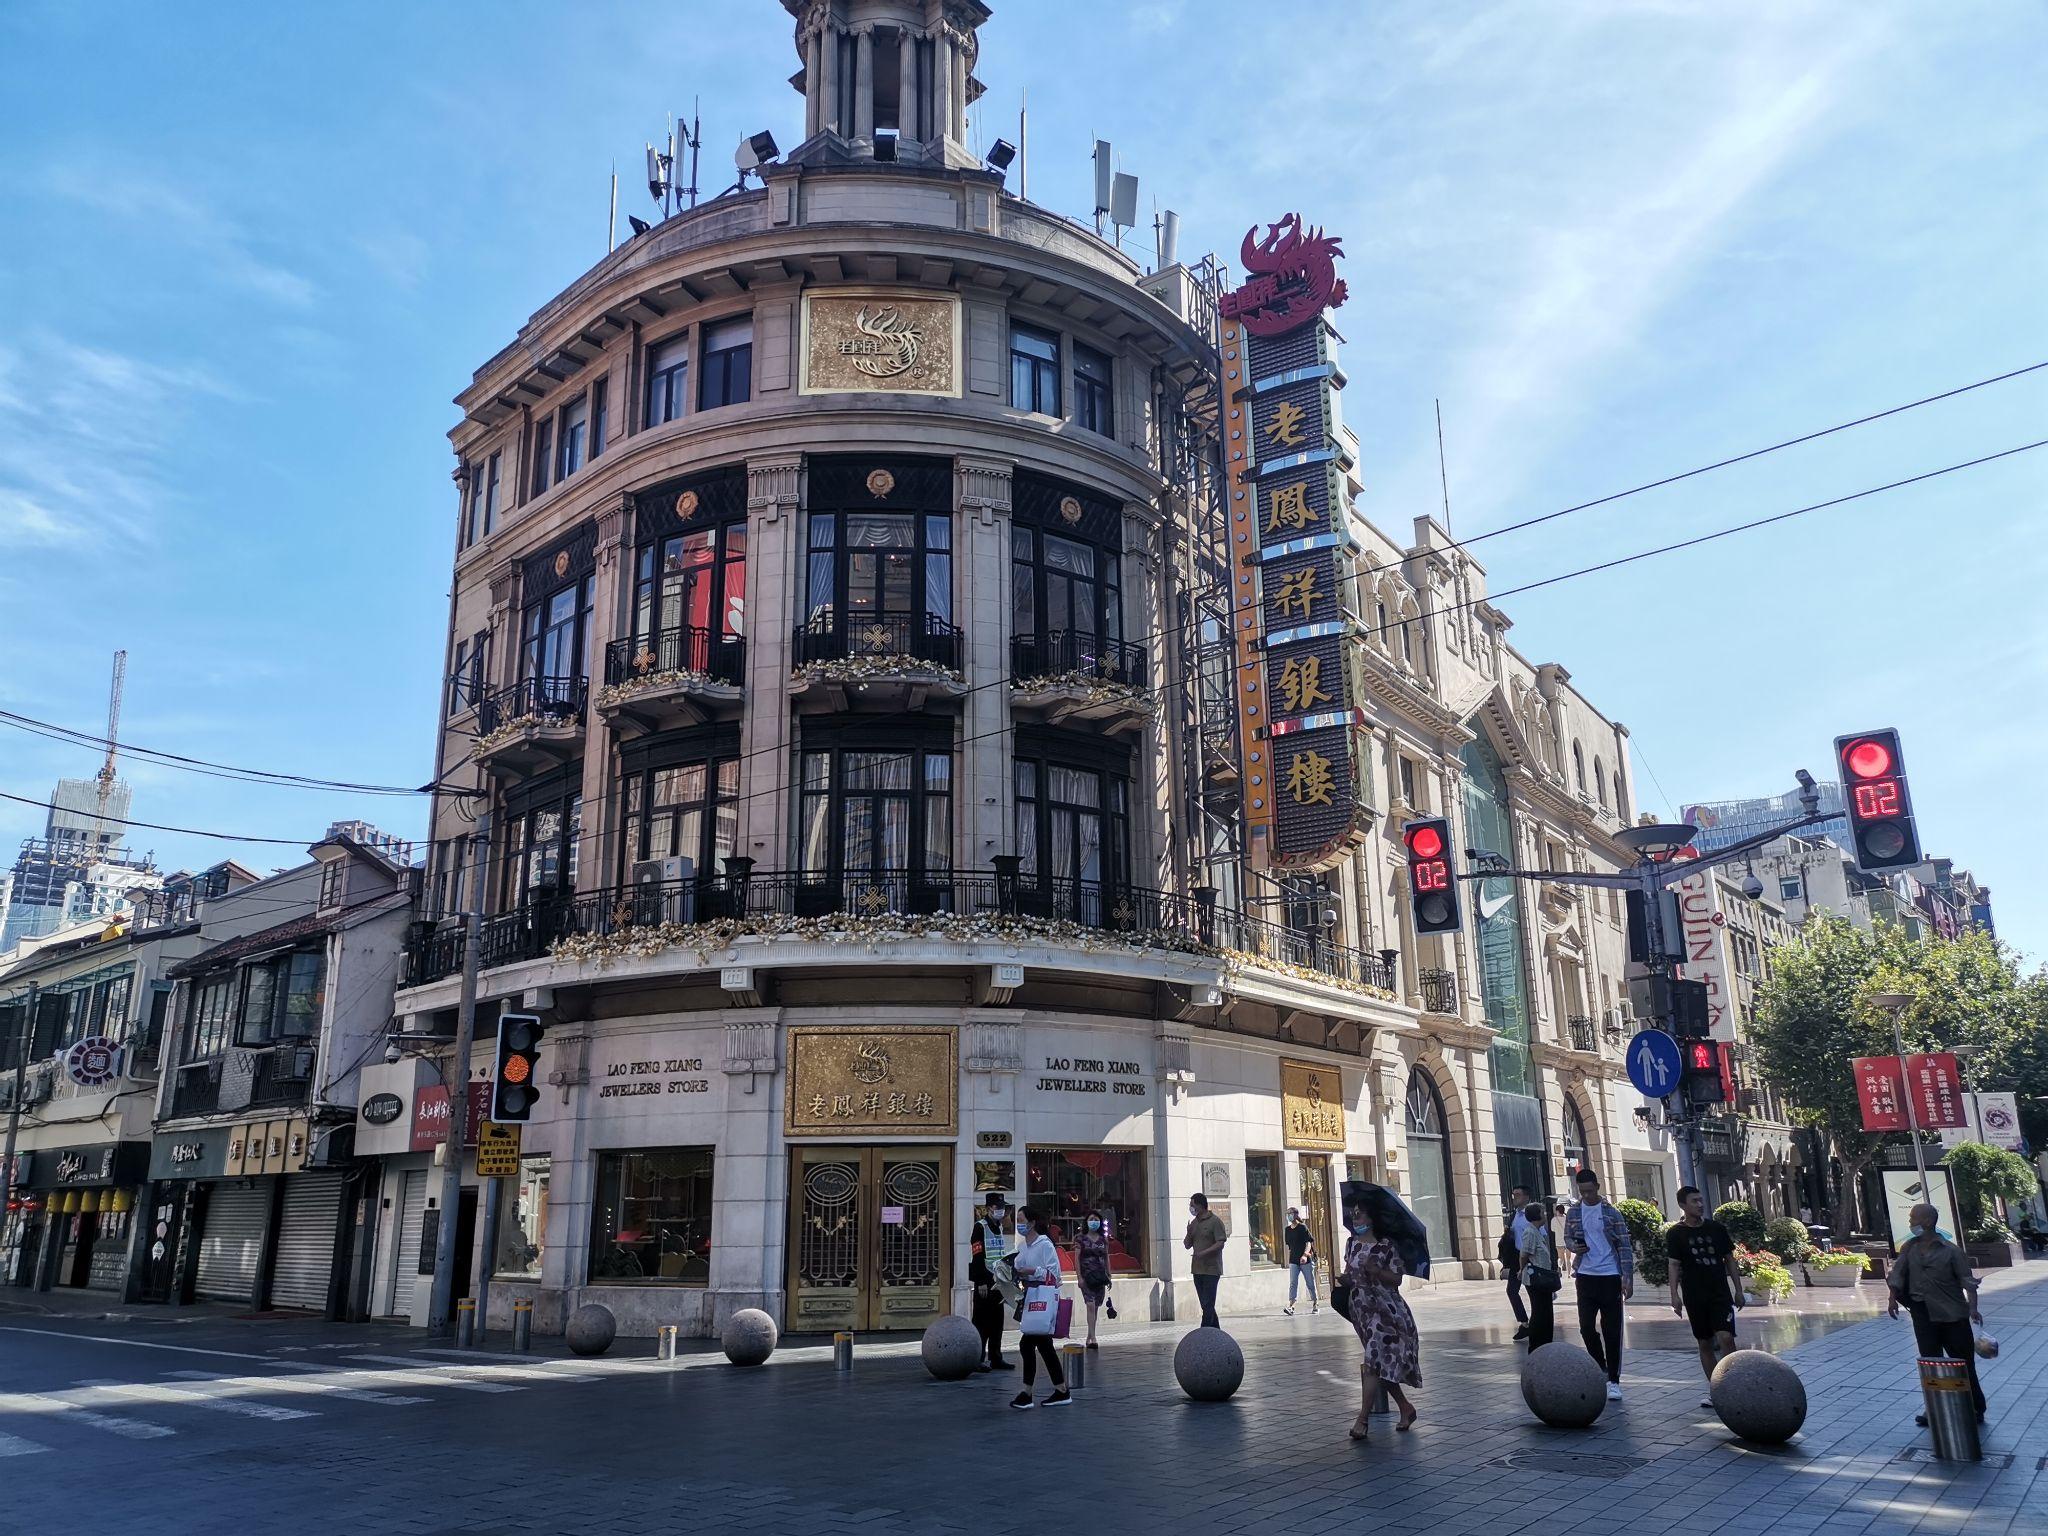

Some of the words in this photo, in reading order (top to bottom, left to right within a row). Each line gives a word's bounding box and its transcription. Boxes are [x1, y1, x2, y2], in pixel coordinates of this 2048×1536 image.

[1264, 401, 1337, 806] 老鳳祥銀樓
[1855, 782, 1898, 817] 02
[1416, 861, 1447, 889] 02
[1679, 872, 1716, 962] GUJIN
[608, 1063, 627, 1076] LAO
[630, 1061, 660, 1075] FENG
[664, 1059, 703, 1073] XIANG
[1046, 1058, 1070, 1071] LAO
[1074, 1059, 1104, 1073] FENG
[1108, 1061, 1140, 1075] XIANG
[600, 1082, 661, 1098] JEWELLERS
[668, 1080, 708, 1093] STORE
[1036, 1078, 1106, 1093] JEWELLERS
[1113, 1082, 1146, 1096] STORE
[1935, 1068, 1955, 1122] 全面建成小康社会
[808, 1091, 934, 1119] 老鳳祥銀樓
[983, 1134, 1007, 1142] 522
